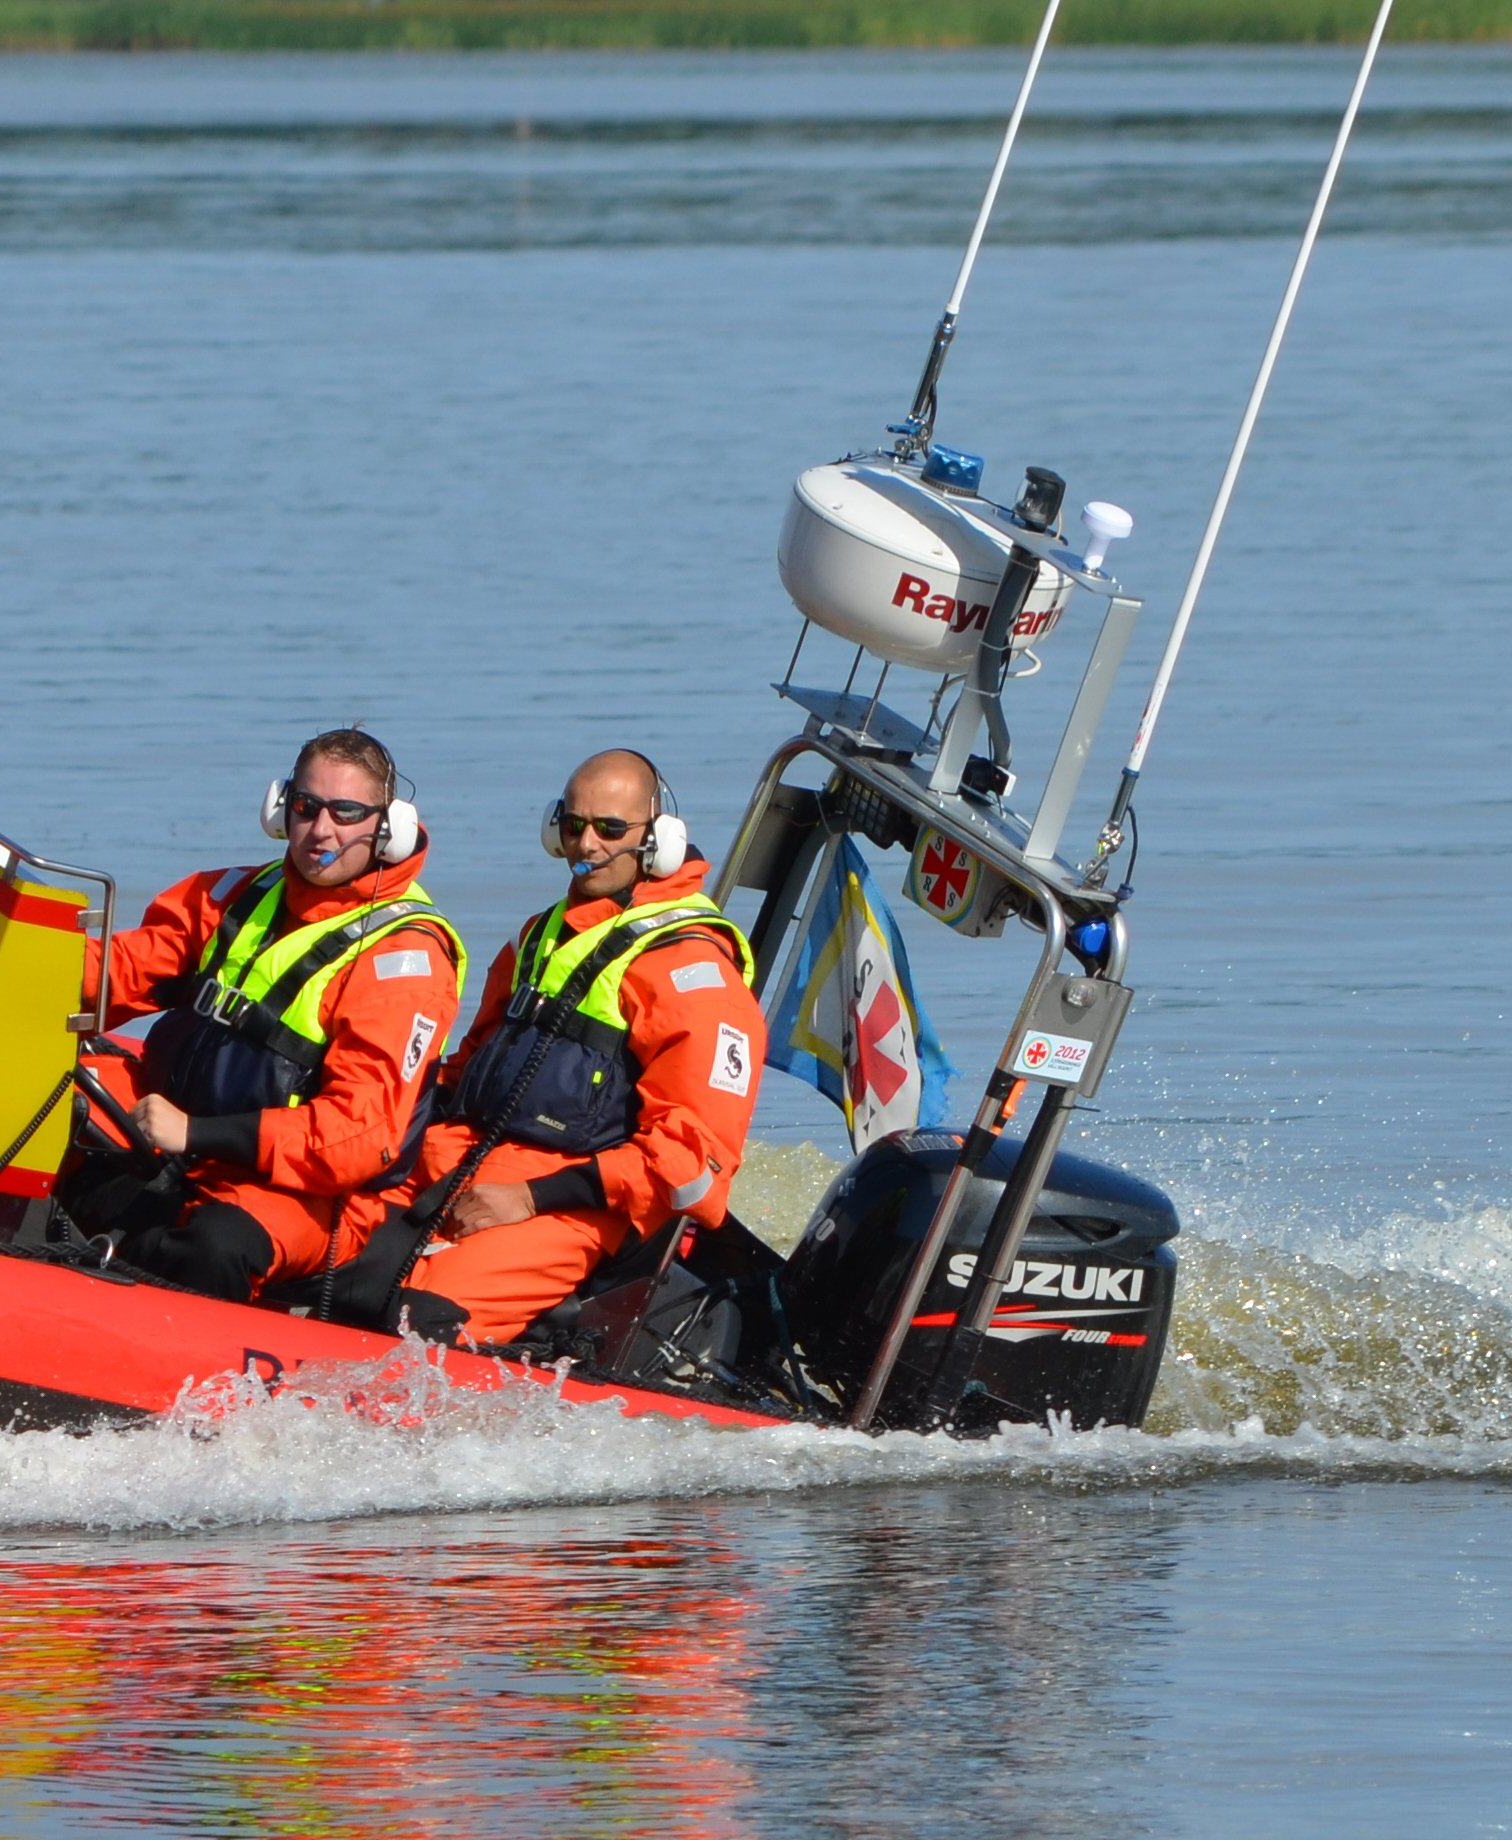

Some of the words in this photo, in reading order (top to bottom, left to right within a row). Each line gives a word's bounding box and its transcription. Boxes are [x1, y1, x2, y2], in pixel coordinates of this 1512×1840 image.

[934, 836, 943, 851] S
[958, 851, 967, 867] S
[947, 892, 956, 907] S
[1055, 1044, 1086, 1060] 2012
[946, 1253, 1144, 1302] SUZUKI
